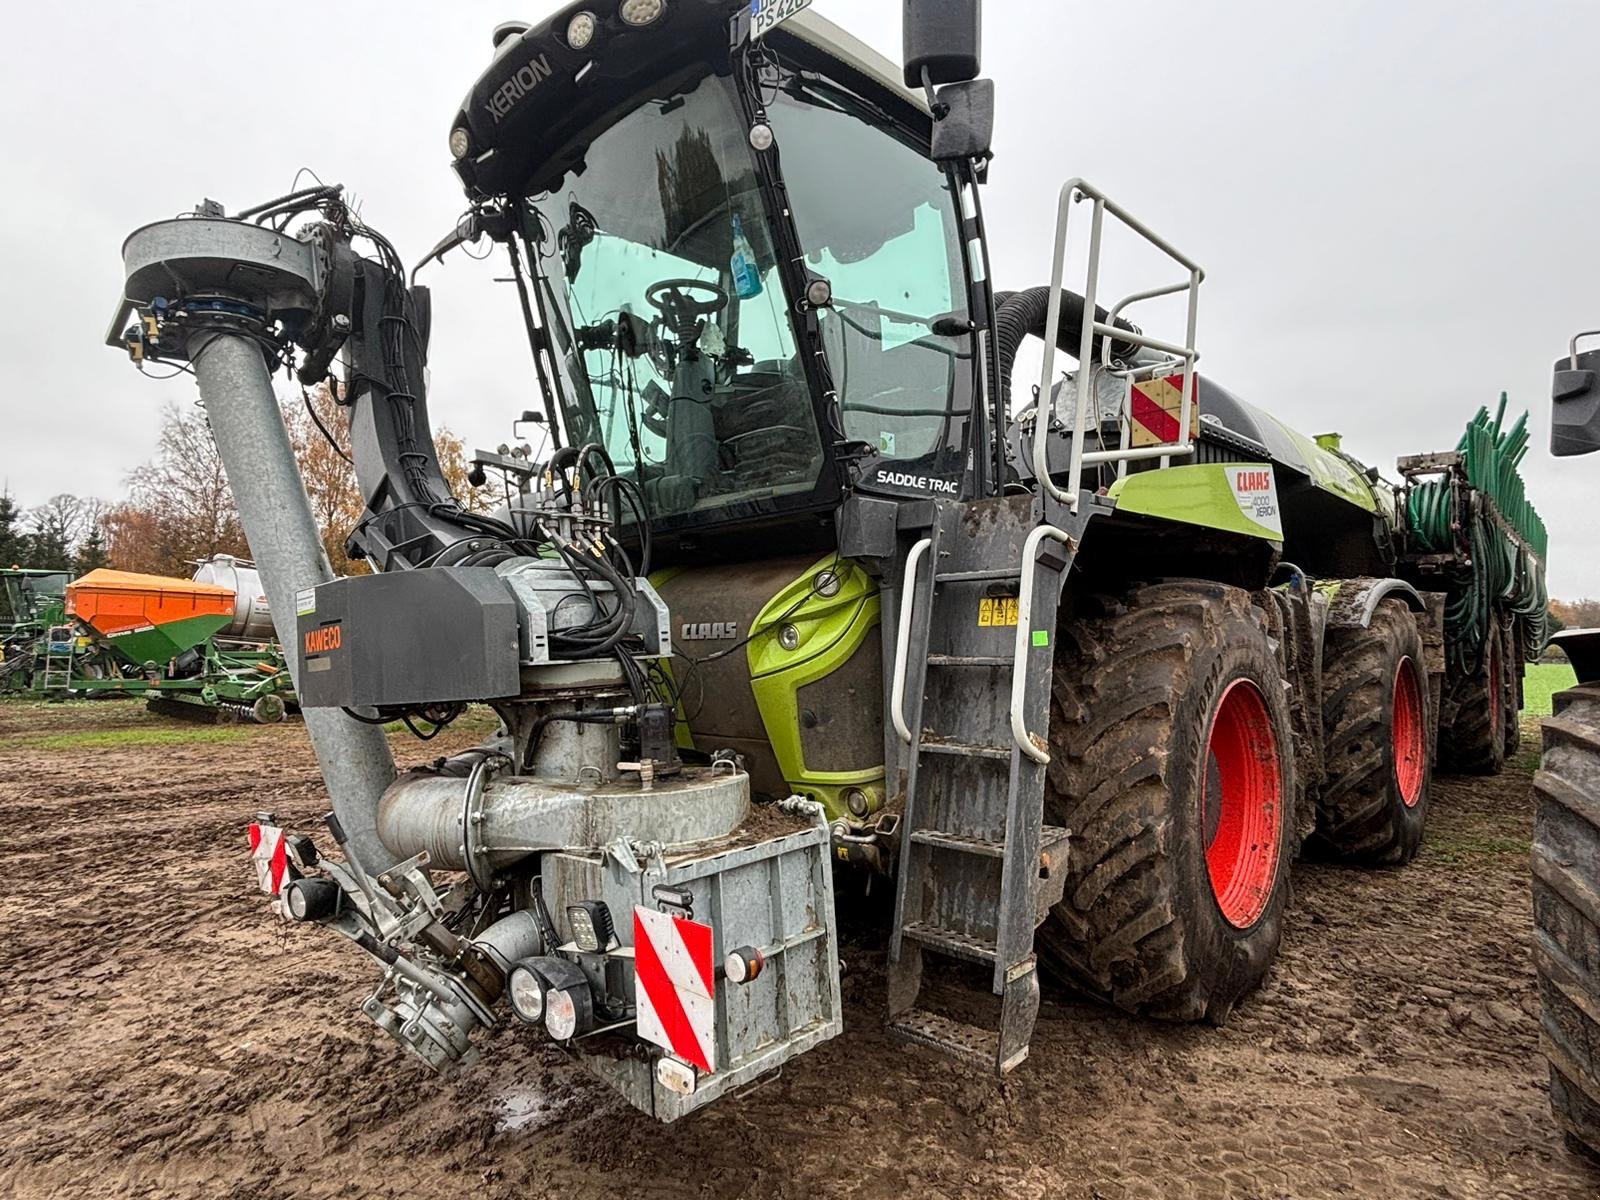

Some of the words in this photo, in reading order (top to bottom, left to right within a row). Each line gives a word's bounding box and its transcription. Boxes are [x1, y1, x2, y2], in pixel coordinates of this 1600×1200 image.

[756, 8, 774, 33] PS
[484, 53, 552, 124] XERION
[877, 470, 926, 489] SADDLE
[928, 479, 958, 493] TRAC
[1236, 472, 1270, 492] CLAAS
[1252, 495, 1270, 506] 4000
[1256, 505, 1276, 518] XERION
[304, 625, 341, 654] KAWECO
[681, 622, 737, 640] CLAAS
